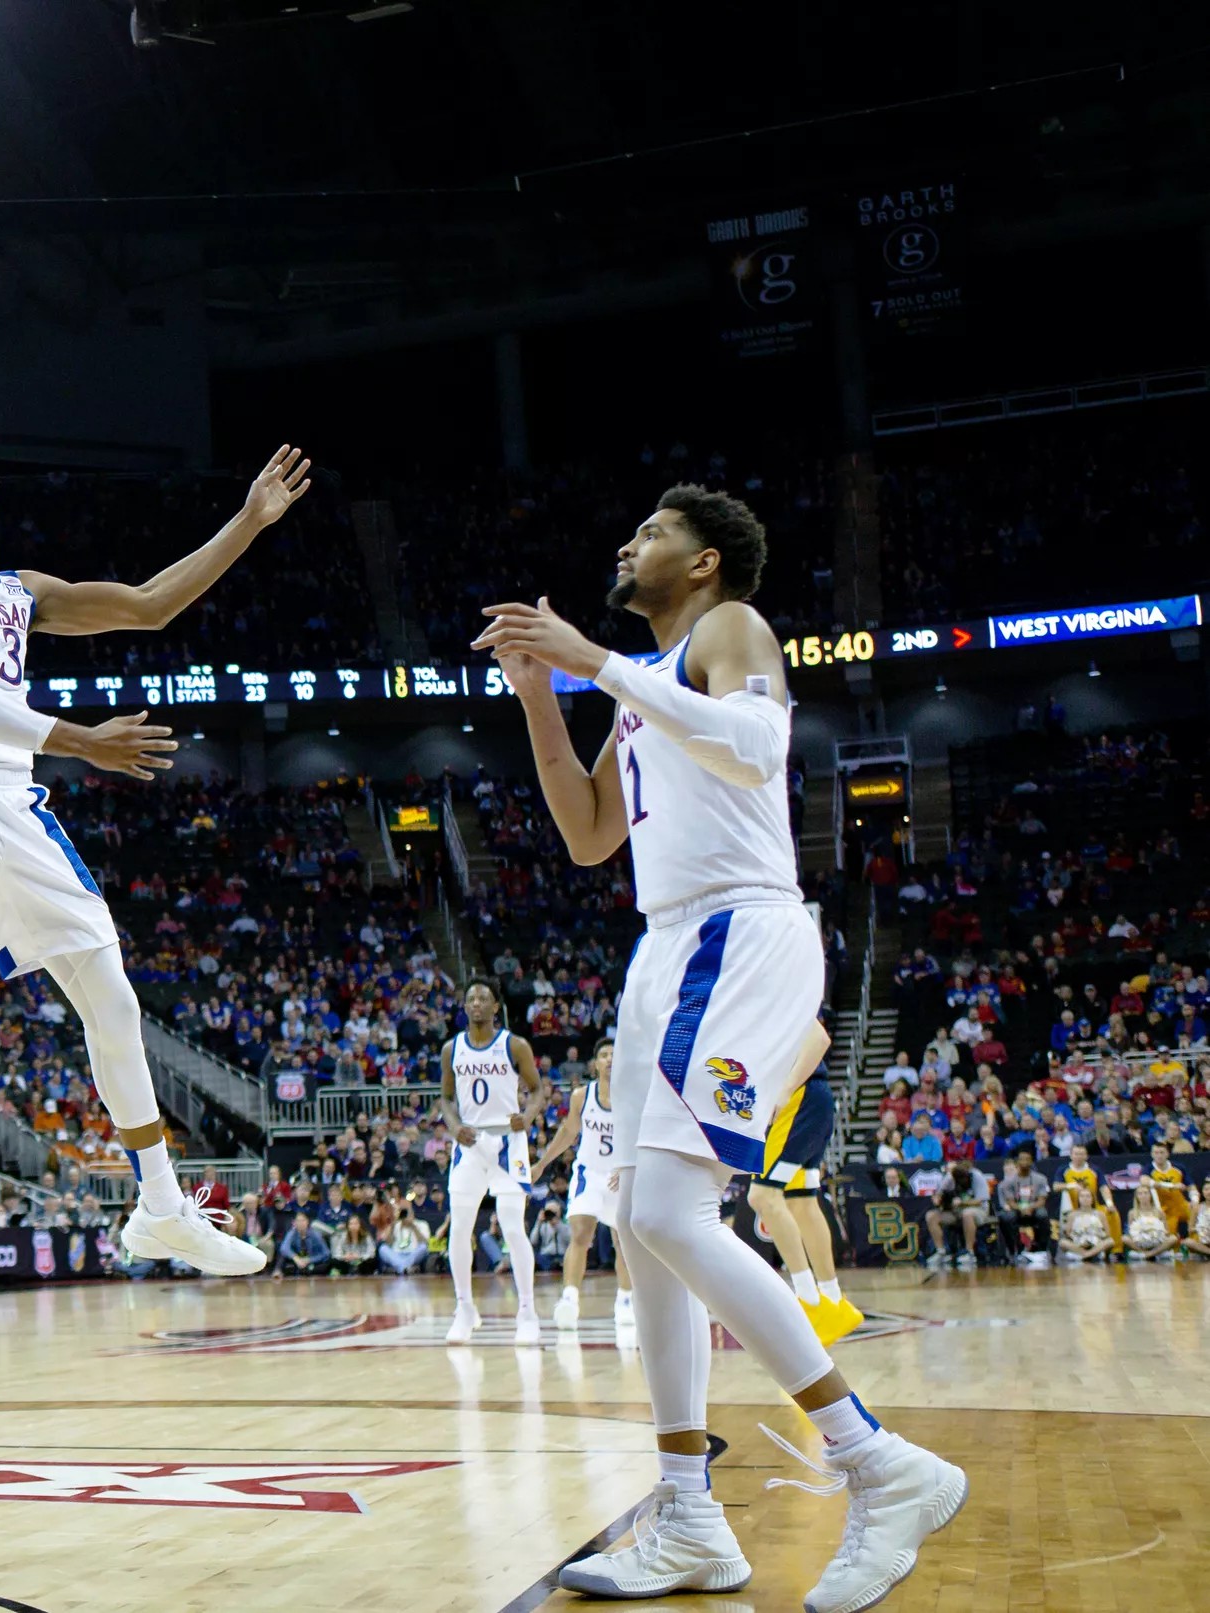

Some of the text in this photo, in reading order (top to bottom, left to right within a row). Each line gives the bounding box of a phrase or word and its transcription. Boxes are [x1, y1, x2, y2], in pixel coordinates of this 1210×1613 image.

[857, 182, 957, 213] GARTH
[706, 204, 810, 244] GARTH BROOKS
[859, 199, 956, 227] BROOKS
[998, 606, 1168, 641] WEST VIRGINIA
[783, 629, 875, 667] 15:40
[891, 629, 939, 652] 2ND
[95, 676, 123, 690] STLS
[141, 675, 161, 688] FLS
[174, 674, 215, 690] TEAM
[395, 665, 440, 682] 3 TOL
[59, 688, 161, 707] 2 1 0
[175, 688, 217, 703] STATS
[245, 682, 357, 702] 23 10 6
[394, 679, 457, 698] 0 FOULS
[626, 744, 649, 828] 1
[455, 1063, 508, 1077] KANSAS
[471, 1077, 489, 1106] 0
[731, 1089, 748, 1103] KU
[599, 1134, 613, 1156] 5
[865, 1201, 920, 1261] BU
